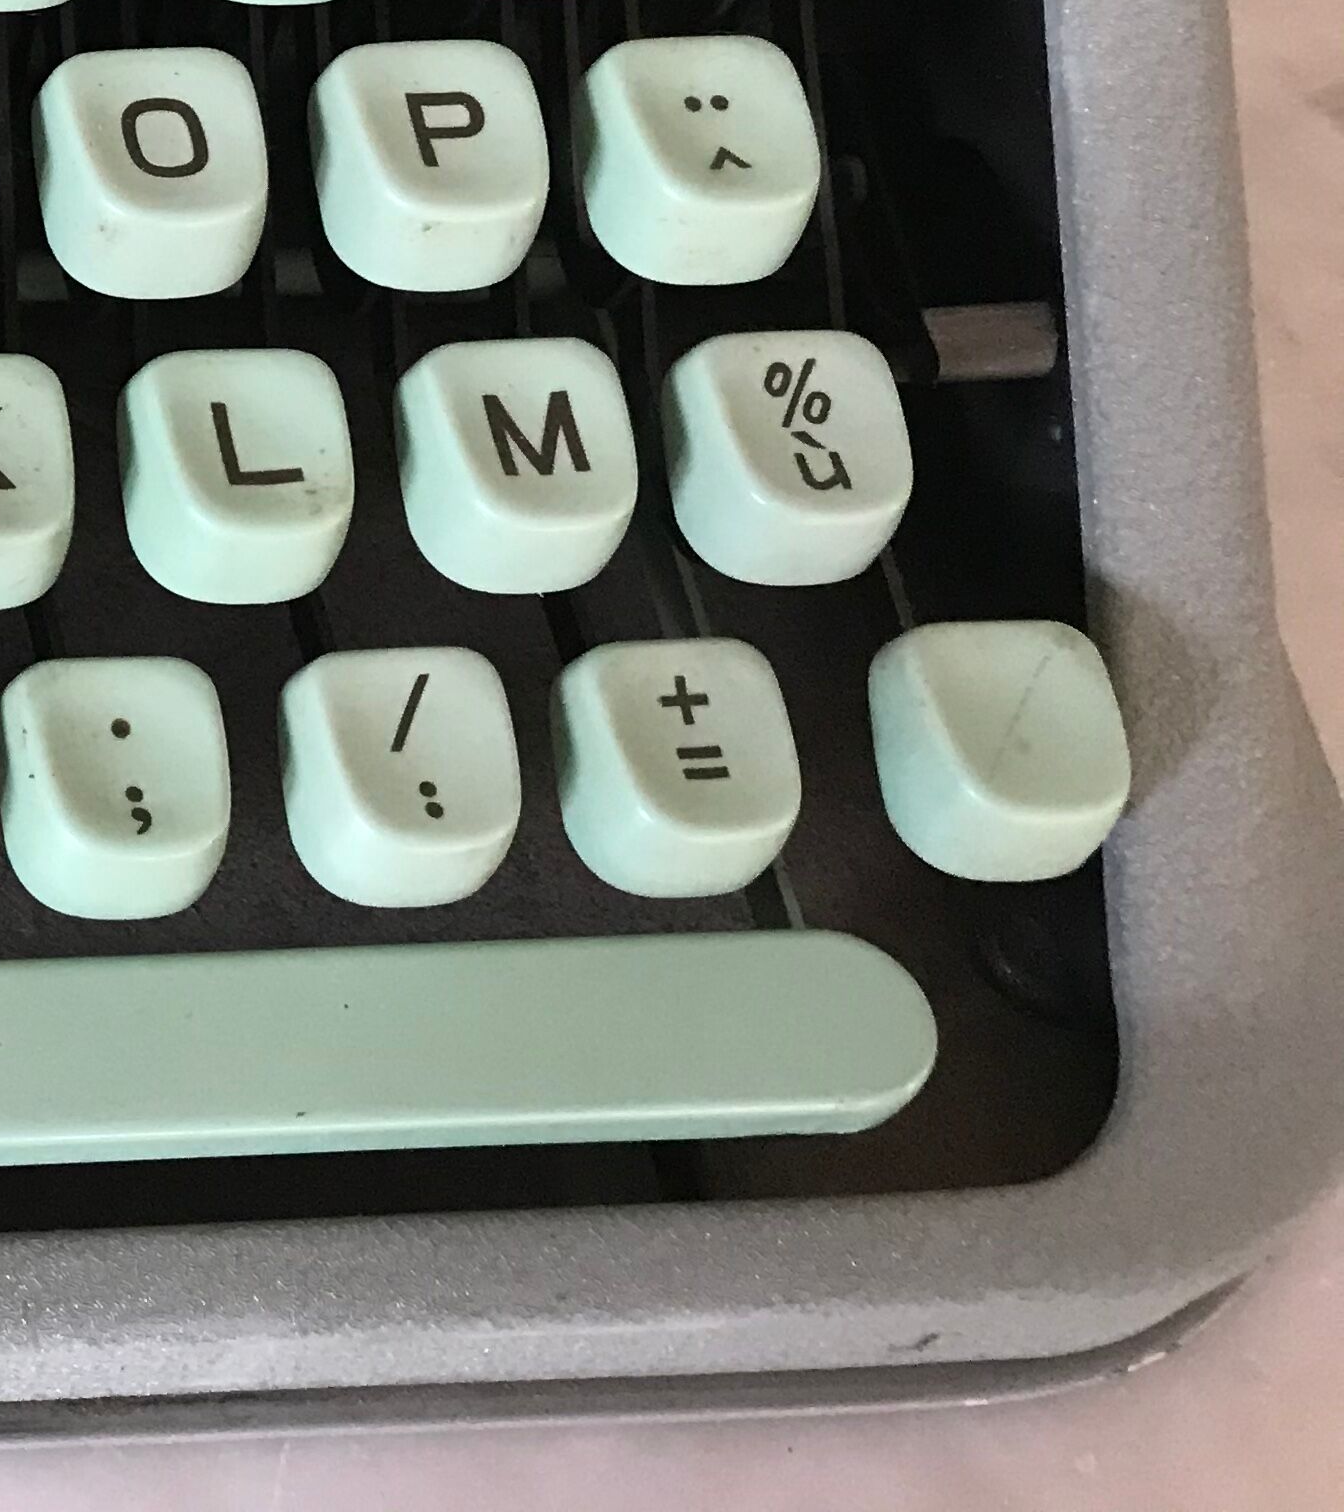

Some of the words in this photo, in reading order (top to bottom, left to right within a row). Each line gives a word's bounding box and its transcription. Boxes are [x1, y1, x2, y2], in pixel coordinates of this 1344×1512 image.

[120, 97, 210, 179] O
[404, 91, 486, 168] P
[763, 358, 832, 429] %
[210, 401, 305, 488] L
[481, 390, 592, 477] M
[790, 430, 853, 491] ù
[657, 675, 710, 726] +
